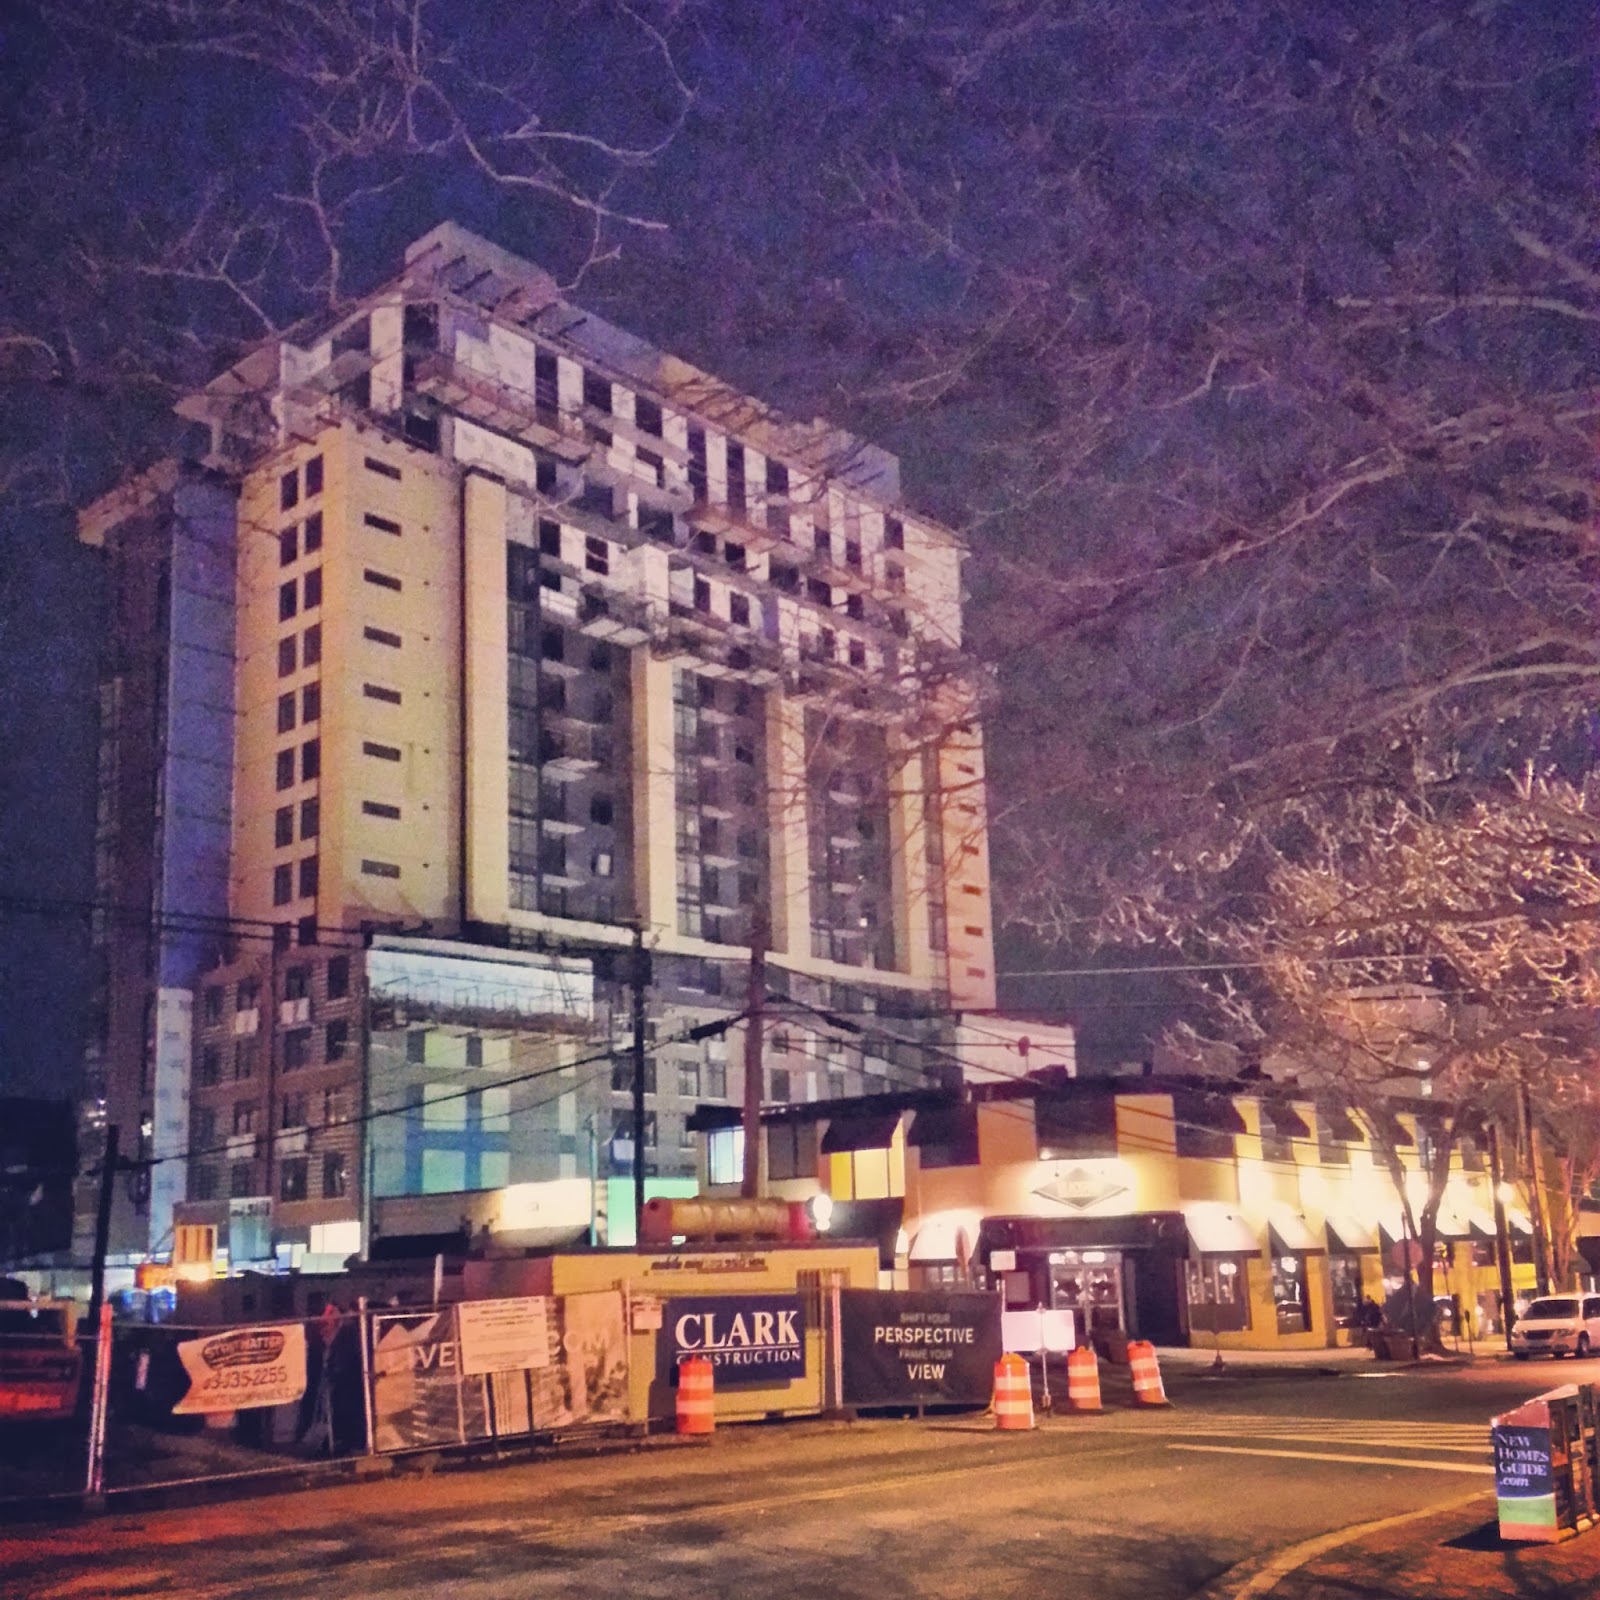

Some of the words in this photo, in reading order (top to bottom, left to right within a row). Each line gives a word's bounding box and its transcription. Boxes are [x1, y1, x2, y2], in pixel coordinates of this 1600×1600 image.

[927, 1312, 951, 1324] YOUR
[675, 1311, 799, 1349] CLARK
[875, 1327, 974, 1343] PERSPECTIVE
[676, 1350, 800, 1365] CNSTRUCTION
[908, 1364, 945, 1379] VIEW
[1499, 1477, 1530, 1487] .com
